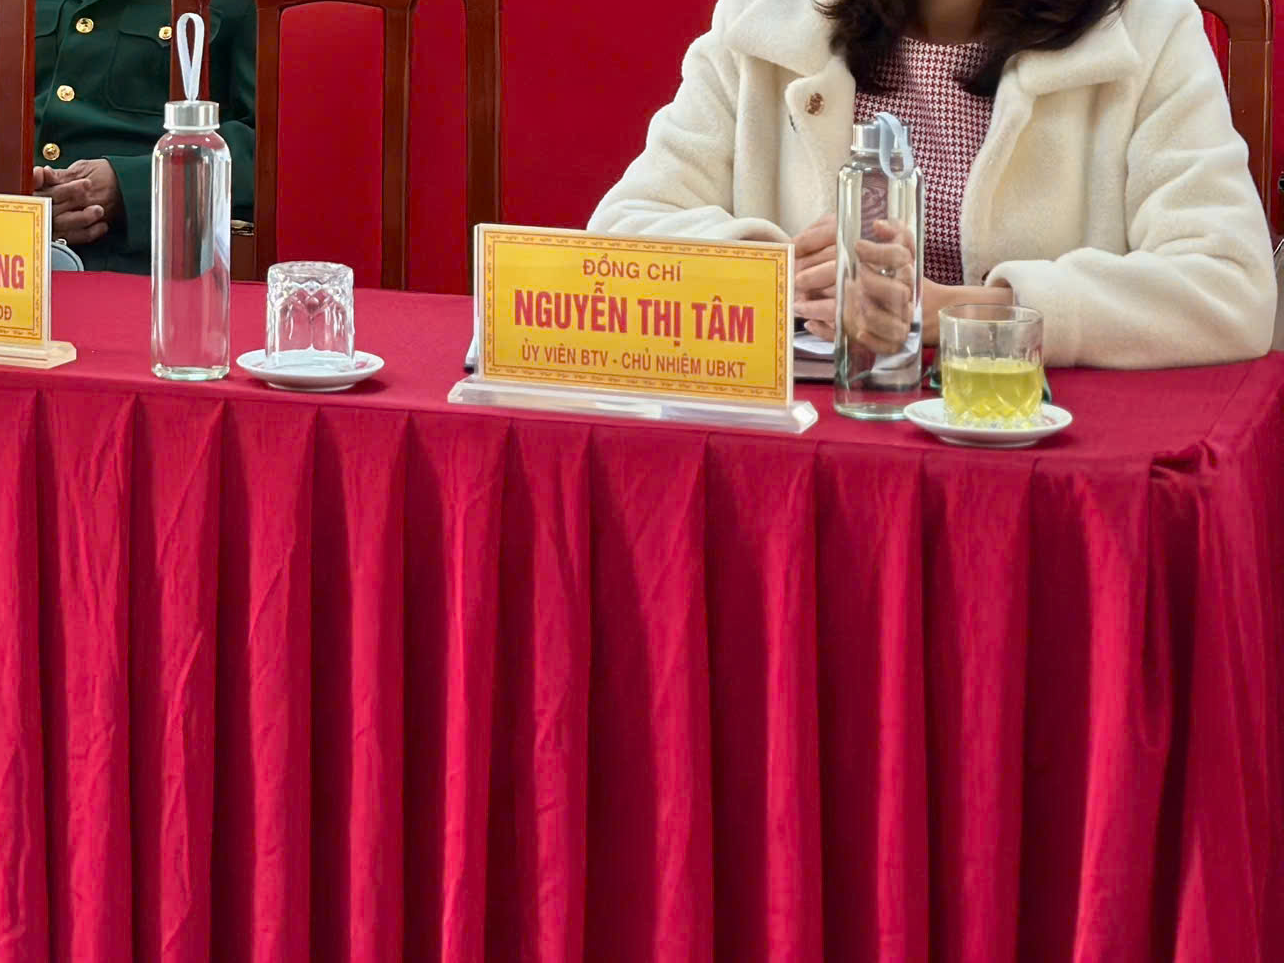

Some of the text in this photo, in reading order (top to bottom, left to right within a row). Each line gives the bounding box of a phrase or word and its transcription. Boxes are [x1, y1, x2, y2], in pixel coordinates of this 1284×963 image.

[647, 260, 681, 281] CHÍ
[514, 281, 754, 347] NGUYỄN THỊ TÂM
[522, 339, 540, 362] ỦY
[544, 343, 576, 364] VIÊN
[581, 350, 608, 367] BTV
[621, 347, 651, 371] CHỦ
[655, 353, 701, 378] NHIỆM
[706, 360, 746, 379] UBKT
